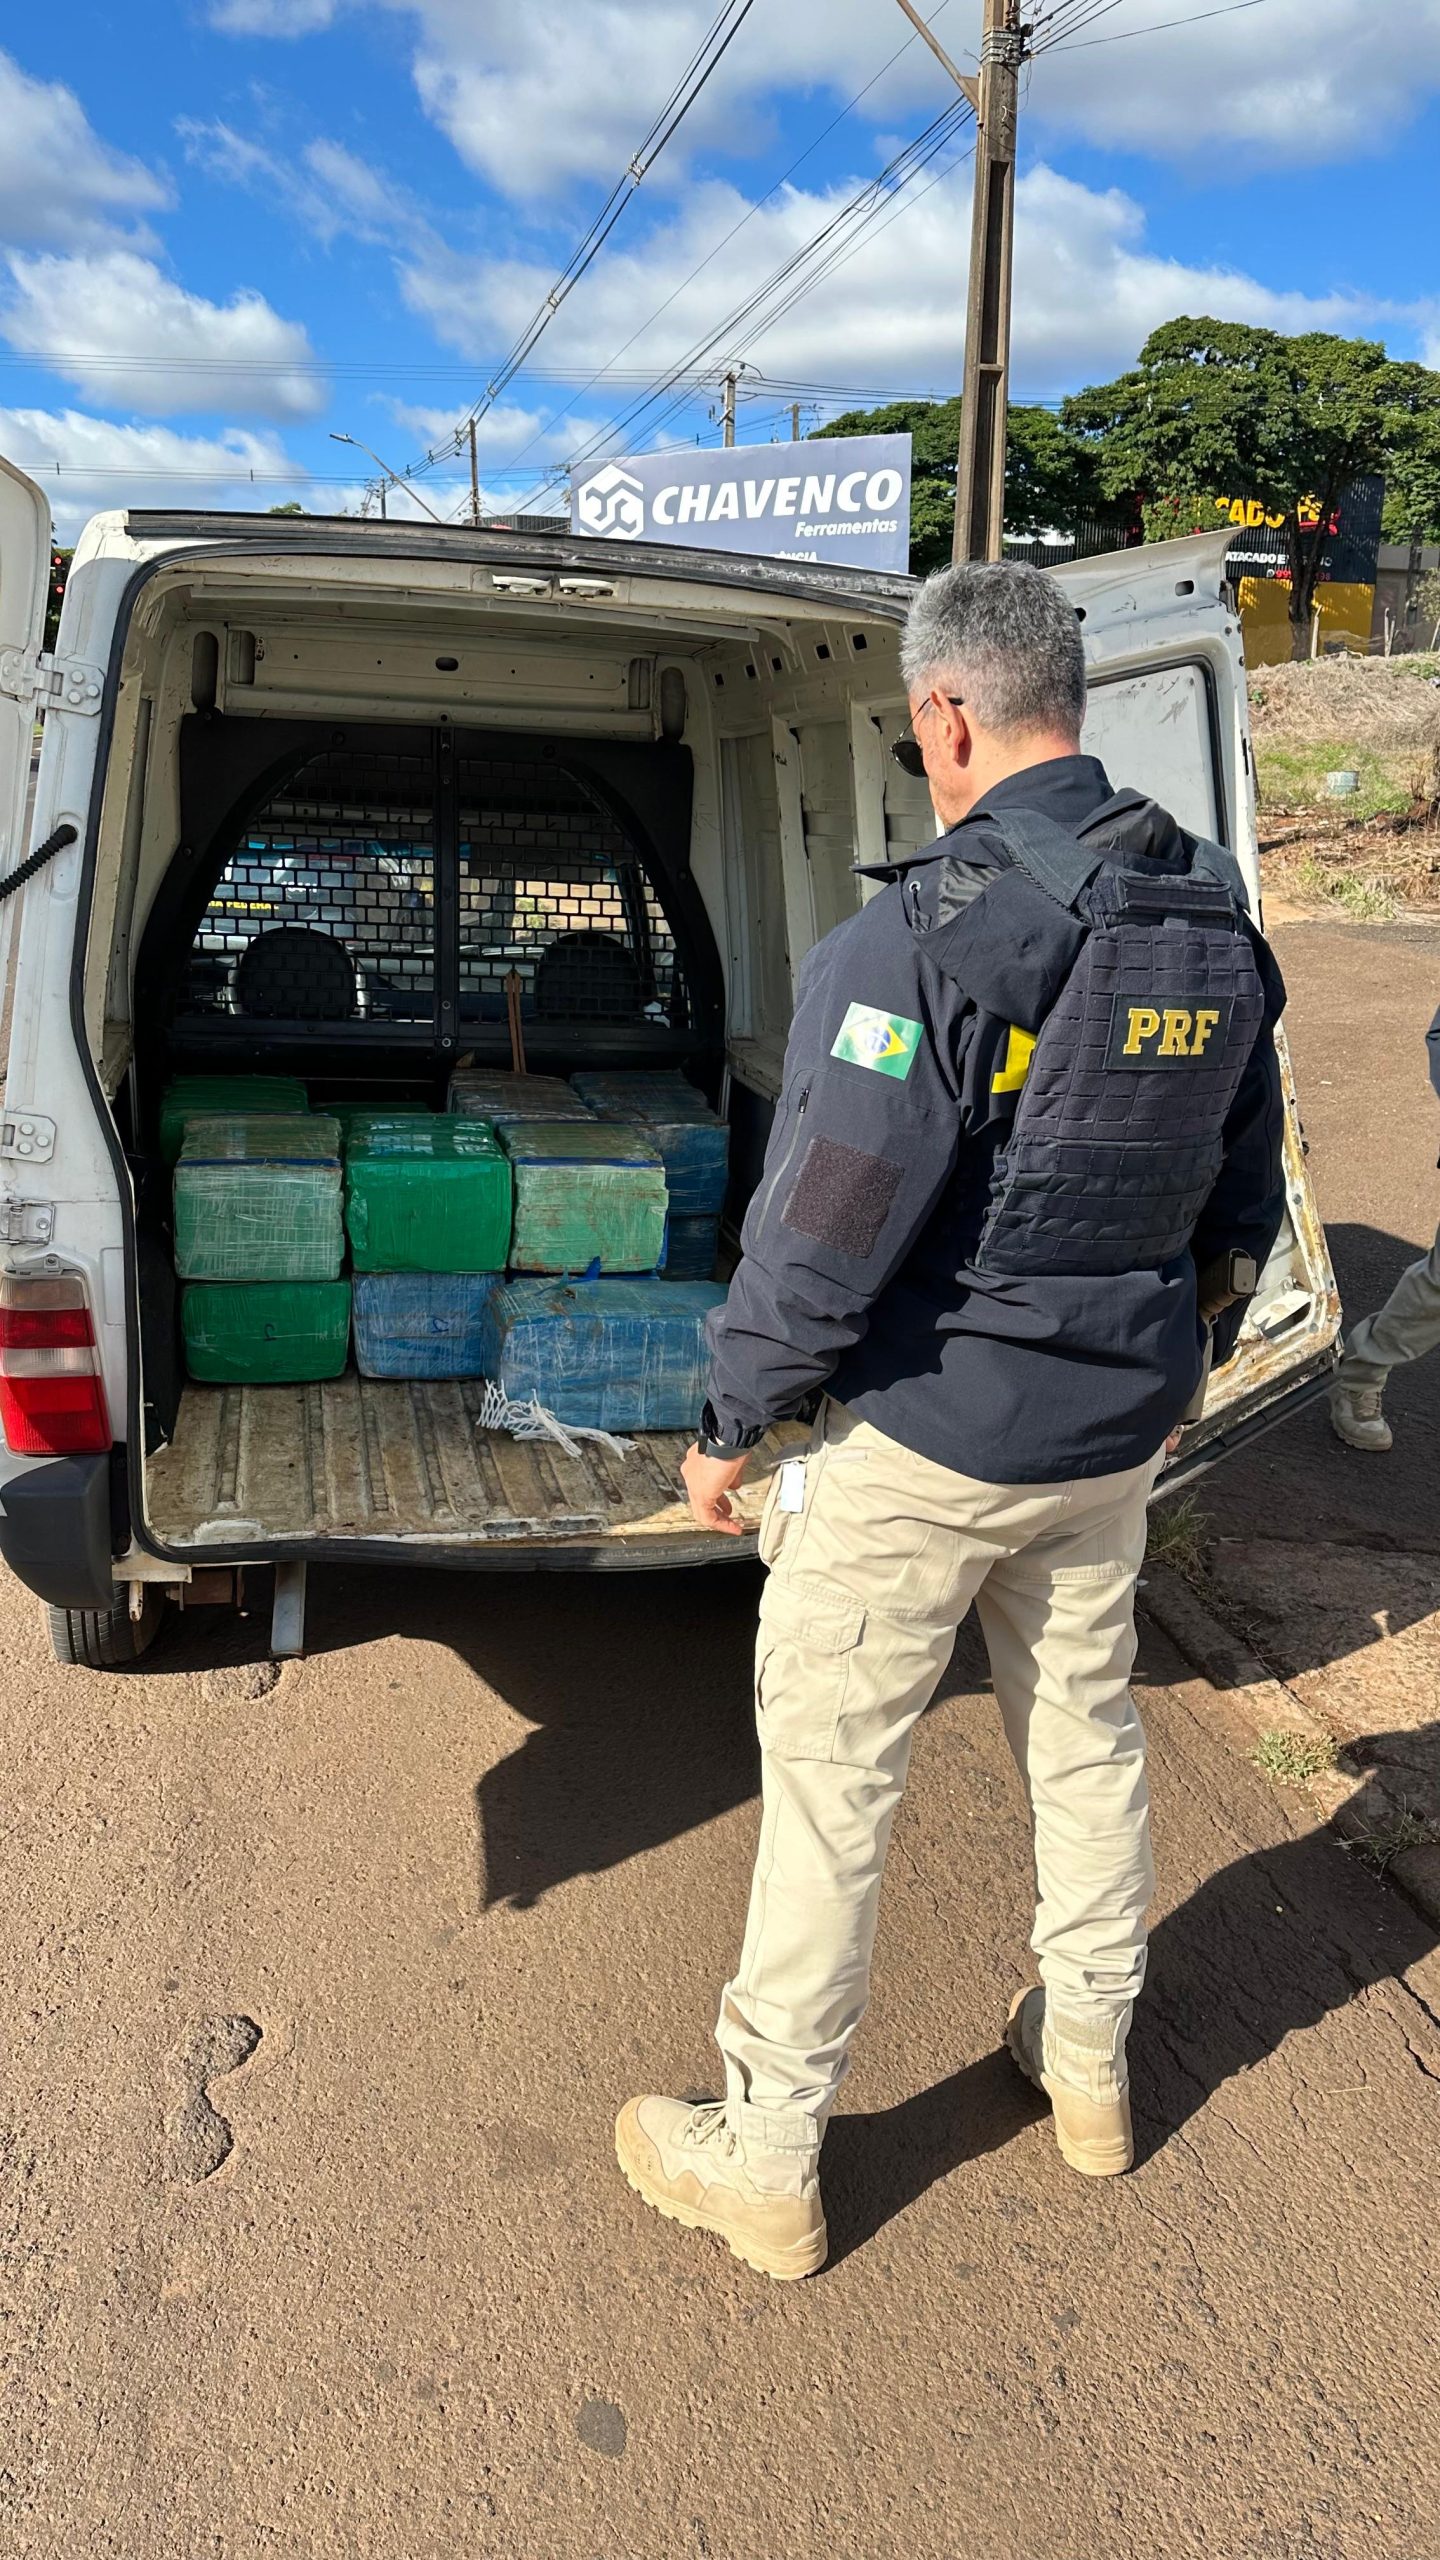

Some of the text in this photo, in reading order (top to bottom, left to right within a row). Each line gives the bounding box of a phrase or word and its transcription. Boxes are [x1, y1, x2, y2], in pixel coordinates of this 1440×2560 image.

[652, 469, 902, 525] CHAVENCO
[795, 519, 897, 538] Ferramentas
[1225, 551, 1276, 564] ATACADO
[1277, 554, 1286, 565] E
[1123, 1008, 1219, 1056] PRF
